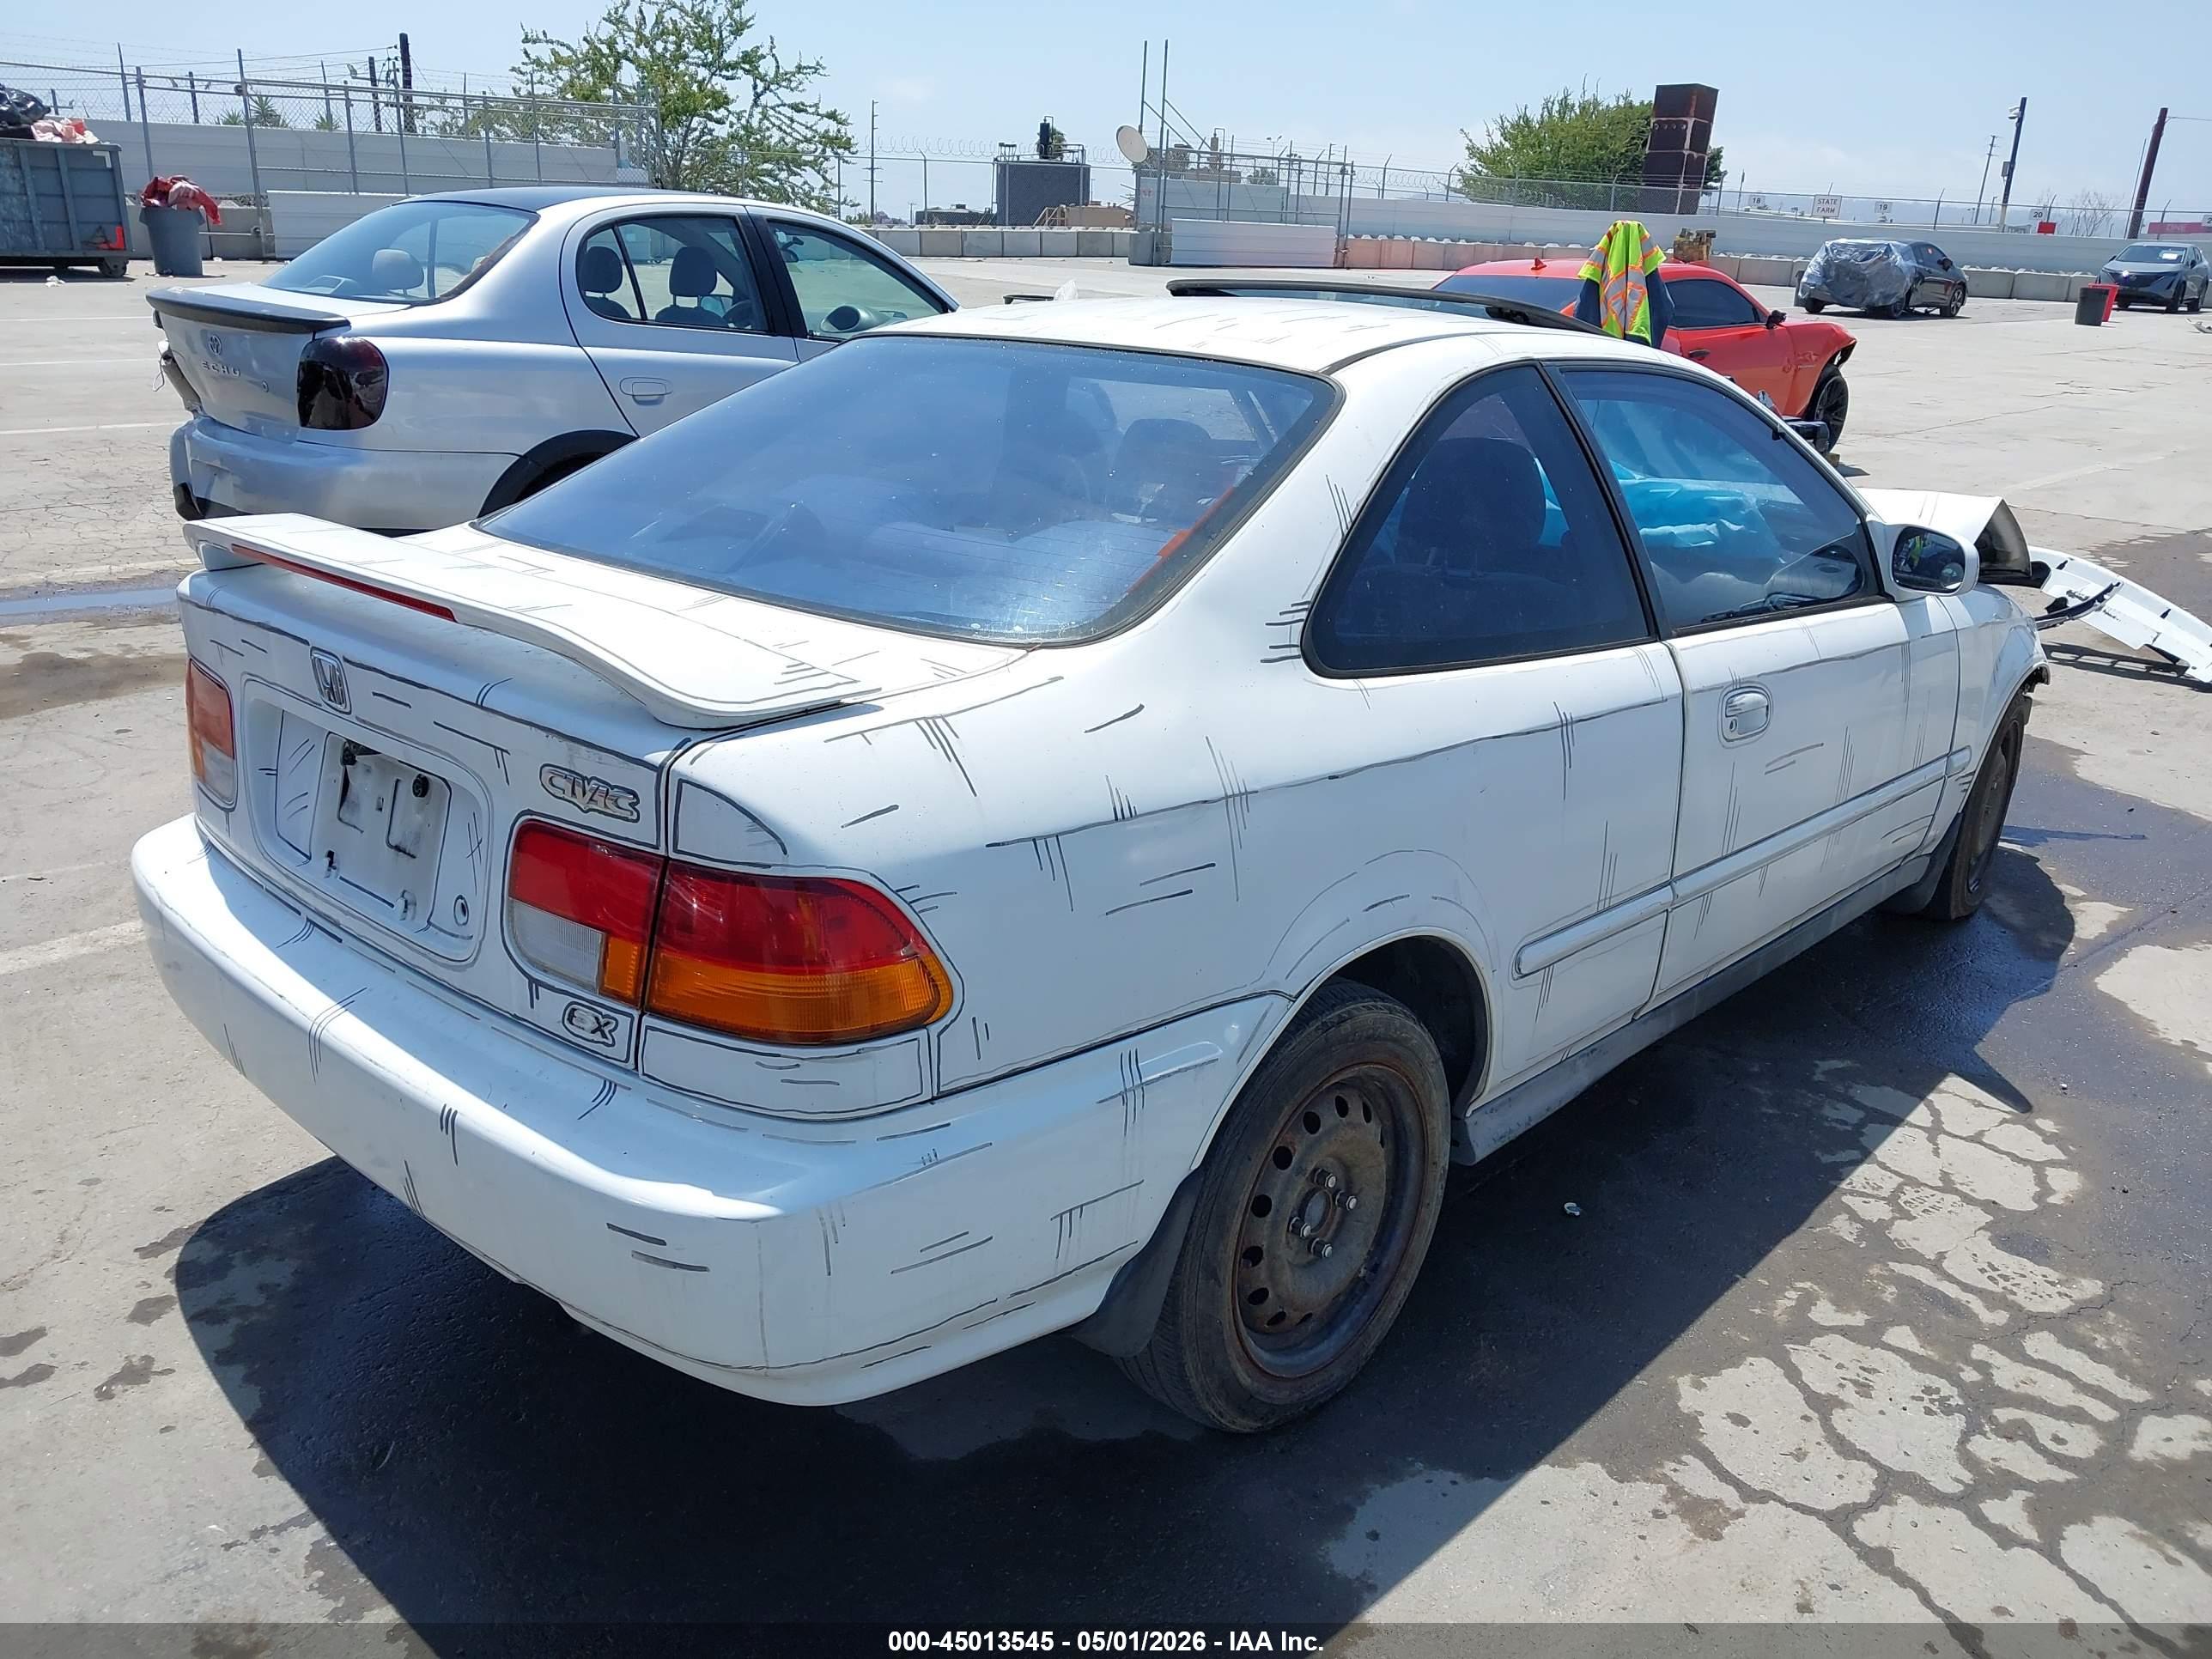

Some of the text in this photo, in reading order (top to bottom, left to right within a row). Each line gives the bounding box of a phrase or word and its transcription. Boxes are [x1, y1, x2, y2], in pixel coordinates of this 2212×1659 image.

[202, 361, 240, 377] ECHO
[542, 769, 635, 817] CIVIC
[567, 1006, 613, 1041] EX
